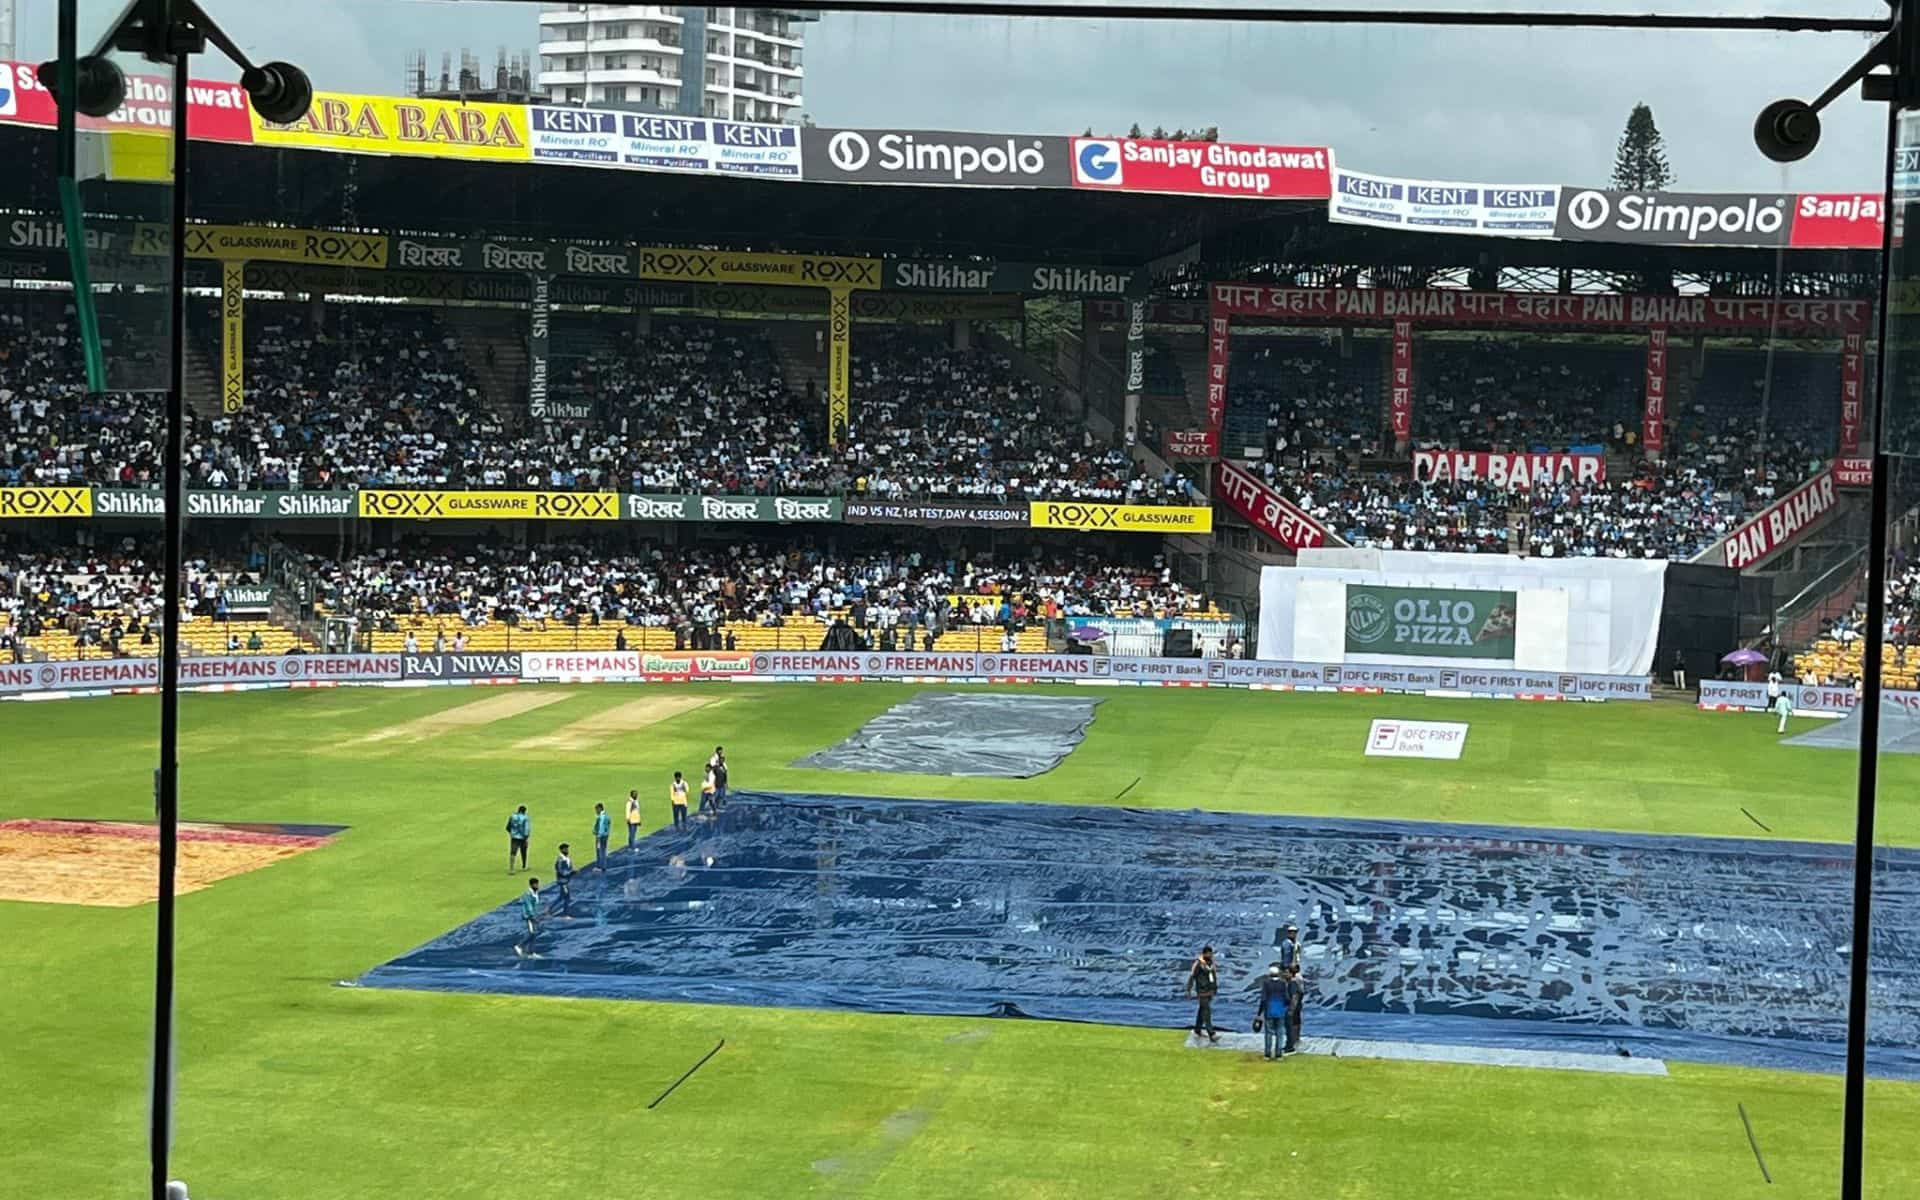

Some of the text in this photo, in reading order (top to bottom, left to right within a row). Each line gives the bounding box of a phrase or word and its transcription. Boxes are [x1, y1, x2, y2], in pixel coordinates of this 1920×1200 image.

[106, 104, 172, 126] Grou
[261, 96, 523, 147] ABA BABA
[543, 110, 603, 132] KENT
[633, 118, 695, 140] KENT
[723, 125, 784, 146] KENT
[1122, 141, 1326, 170] Sanjay Ghodawat
[1200, 167, 1270, 193] Group
[1346, 177, 1393, 198] KENT
[1416, 185, 1469, 204] KENT
[1493, 191, 1545, 207] KENT
[220, 235, 298, 250] GLASSWARE
[304, 235, 382, 263] ROXX
[399, 240, 463, 267] शिखर
[483, 243, 547, 270] शिखर
[566, 246, 630, 274] शिखर
[642, 252, 876, 284] ROXX GLASSWARE ROXX
[895, 263, 994, 289] Shikhar
[1032, 266, 1131, 293] Shikhar
[227, 270, 240, 318] ROXX
[1335, 290, 1455, 315] PAN BAHAR
[533, 277, 548, 338] Shikhar
[1582, 298, 1704, 322] PAN BAHAR
[833, 296, 847, 342] ROXX
[227, 374, 240, 412] OXX
[530, 357, 547, 418] Shikhar
[1, 490, 84, 513] ROXX
[96, 492, 165, 513] Shikha
[187, 493, 266, 514] Shikhar
[278, 494, 353, 514] Shikhar
[365, 493, 612, 517] ROXX GLASSWARE ROXX
[629, 494, 685, 520] शिखर
[701, 496, 758, 520] शिखर
[774, 496, 832, 520] शिखर
[847, 505, 868, 516] IND
[870, 506, 883, 517] VS
[1021, 511, 1028, 520] 2
[1048, 505, 1195, 526] ROXX GLASSWARE
[1724, 474, 1835, 569] PAN BAHAR
[1393, 598, 1475, 625] OLIO
[1393, 624, 1474, 646] PIZZA
[60, 663, 157, 682] FREEMANS
[180, 661, 276, 678] FREEMANS
[304, 658, 400, 675] FREEMANS
[405, 655, 521, 676] RAJ NIWAS
[546, 657, 636, 671] FREEMANS
[772, 656, 861, 670] FREEMANS
[885, 656, 974, 671] FREEMANS
[1000, 658, 1088, 673] FREEMANS
[1113, 664, 1203, 675] IDFC FIRST Bank
[1228, 666, 1319, 679] IDFC FIRST Bank
[1344, 671, 1434, 683] IDFC FIRST Bank
[1461, 675, 1553, 689] IDFC FIRST Bank
[1579, 680, 1607, 691] IDFC
[1609, 681, 1641, 692] FIRST
[1703, 687, 1726, 697] DFC
[1730, 689, 1762, 699] FIRST
